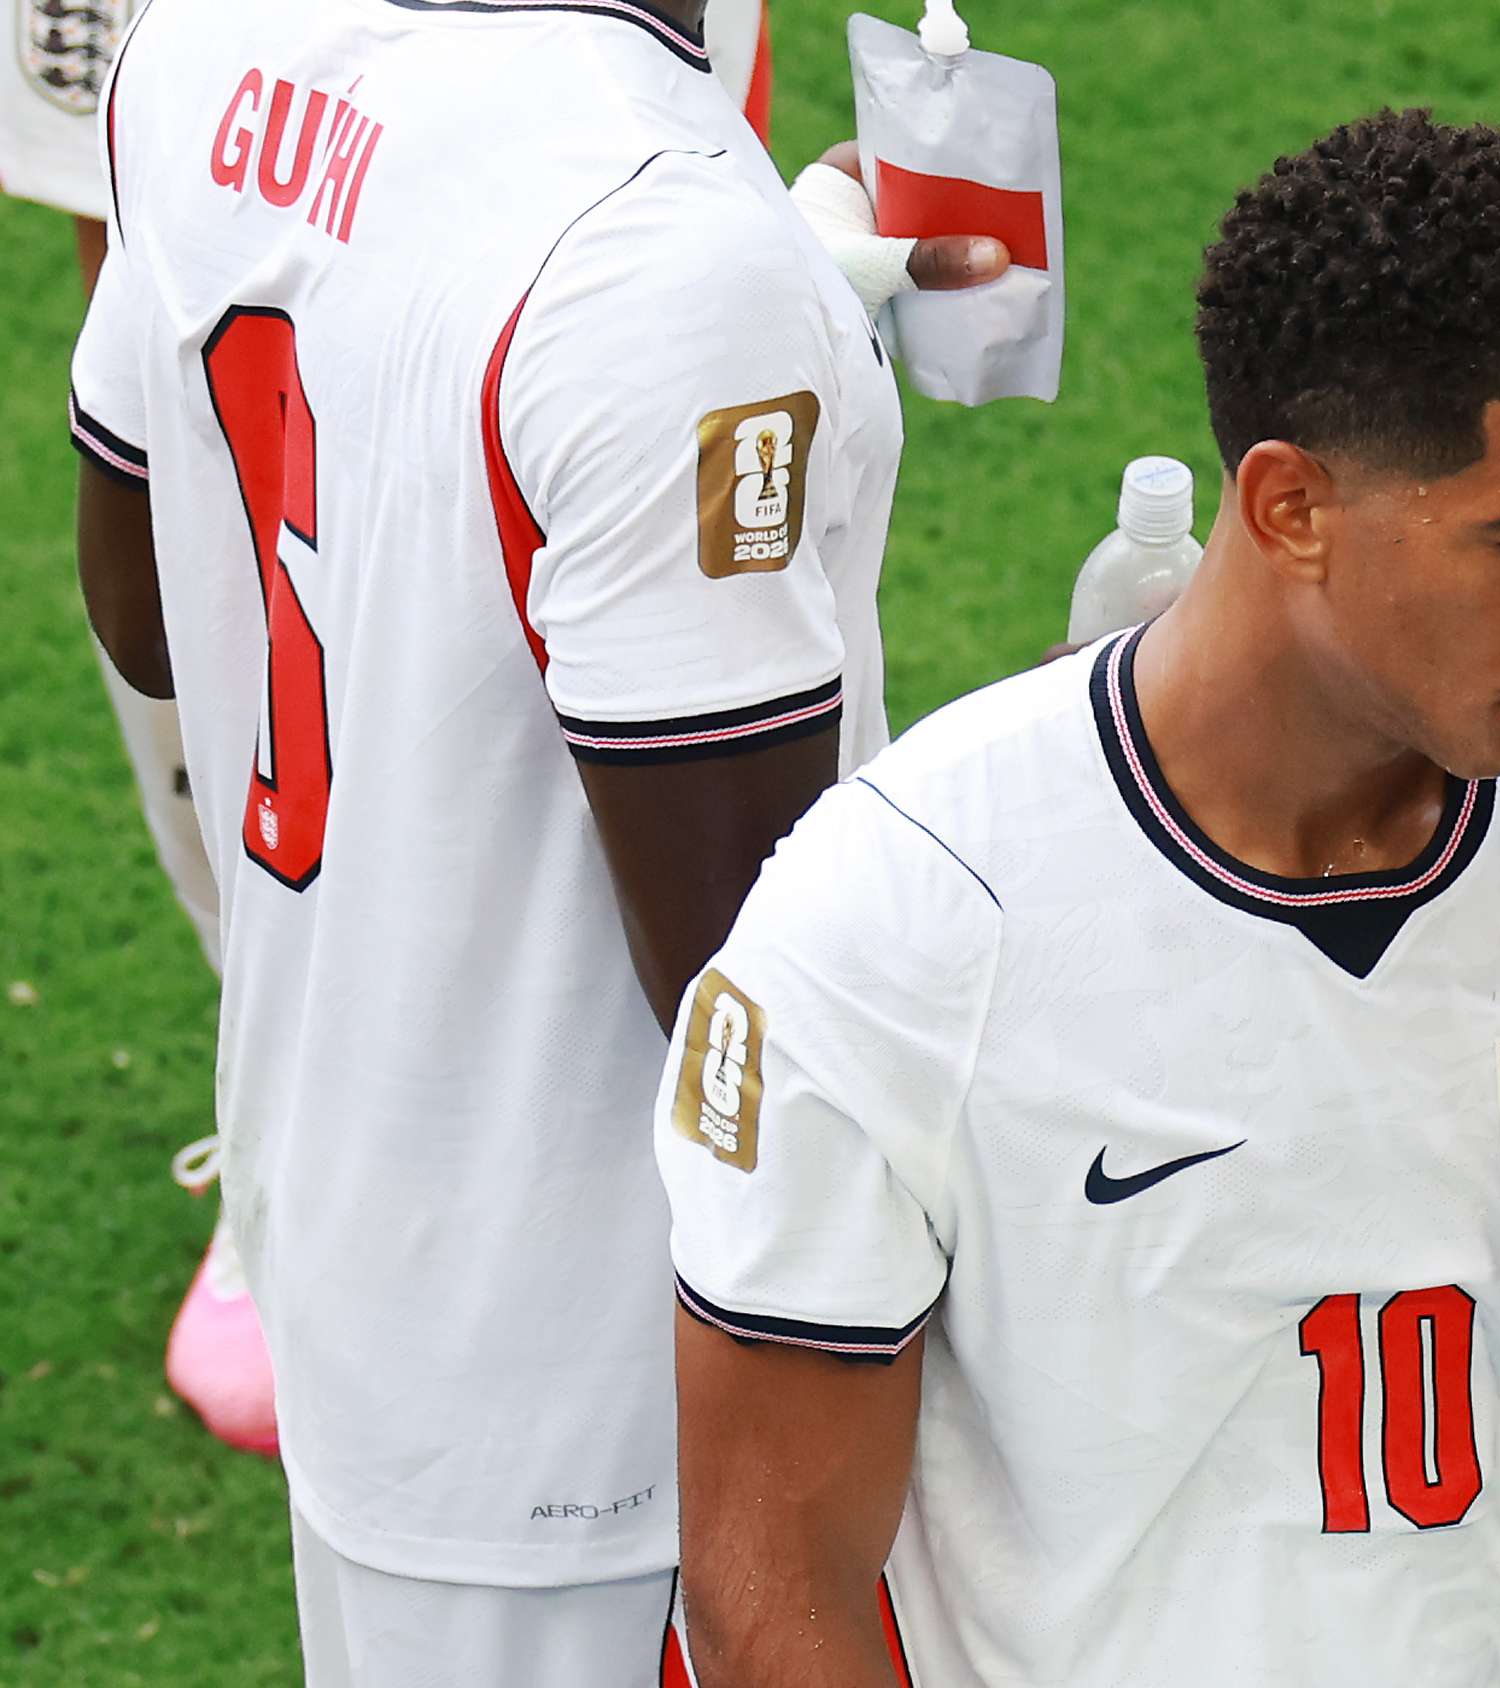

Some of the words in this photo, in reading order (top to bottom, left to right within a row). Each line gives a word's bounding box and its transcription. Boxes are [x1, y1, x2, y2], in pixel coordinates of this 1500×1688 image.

[210, 67, 385, 245] GUHI
[755, 502, 782, 517] FIFA
[734, 529, 779, 545] WORLD
[1298, 1283, 1483, 1534] 10
[530, 1484, 657, 1520] AERO-FIT
